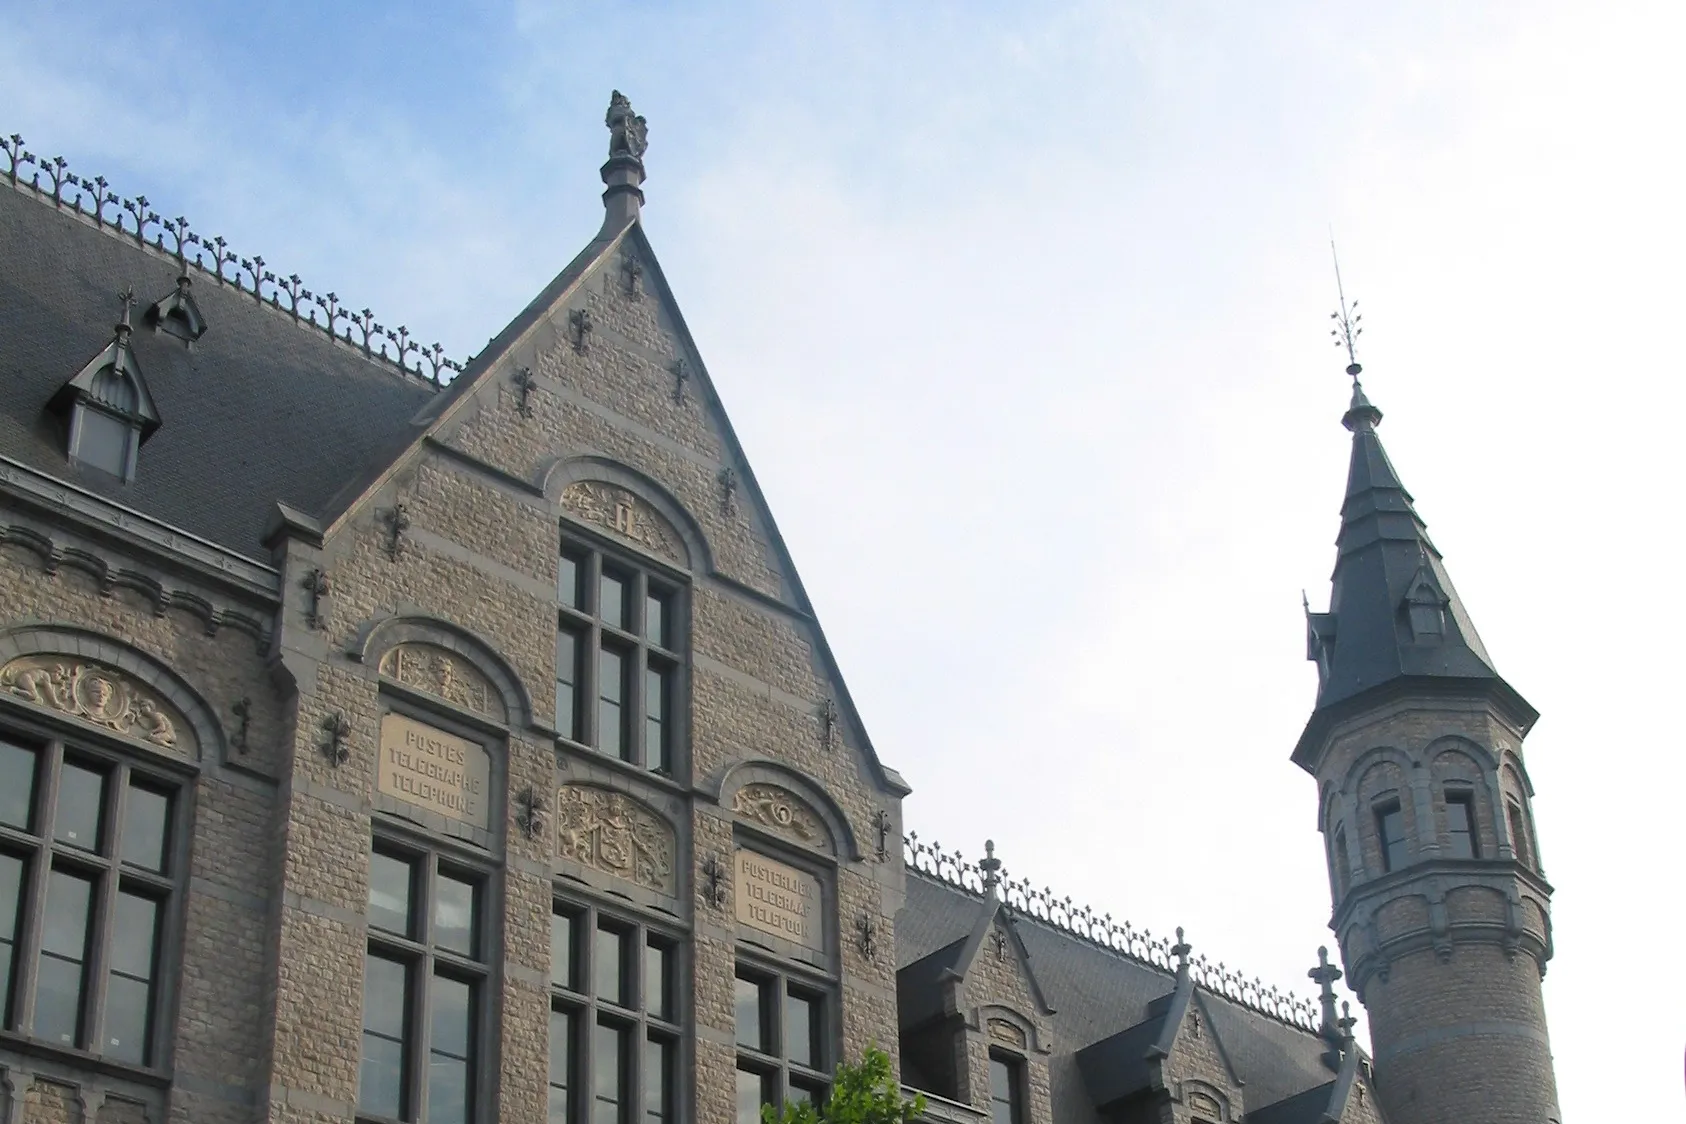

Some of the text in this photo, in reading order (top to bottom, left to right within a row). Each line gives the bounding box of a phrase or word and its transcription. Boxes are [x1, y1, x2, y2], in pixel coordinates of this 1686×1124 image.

[406, 730, 465, 766] POSTES
[389, 747, 480, 795] TELEGRAPHE
[392, 772, 475, 816] TELEPHONE
